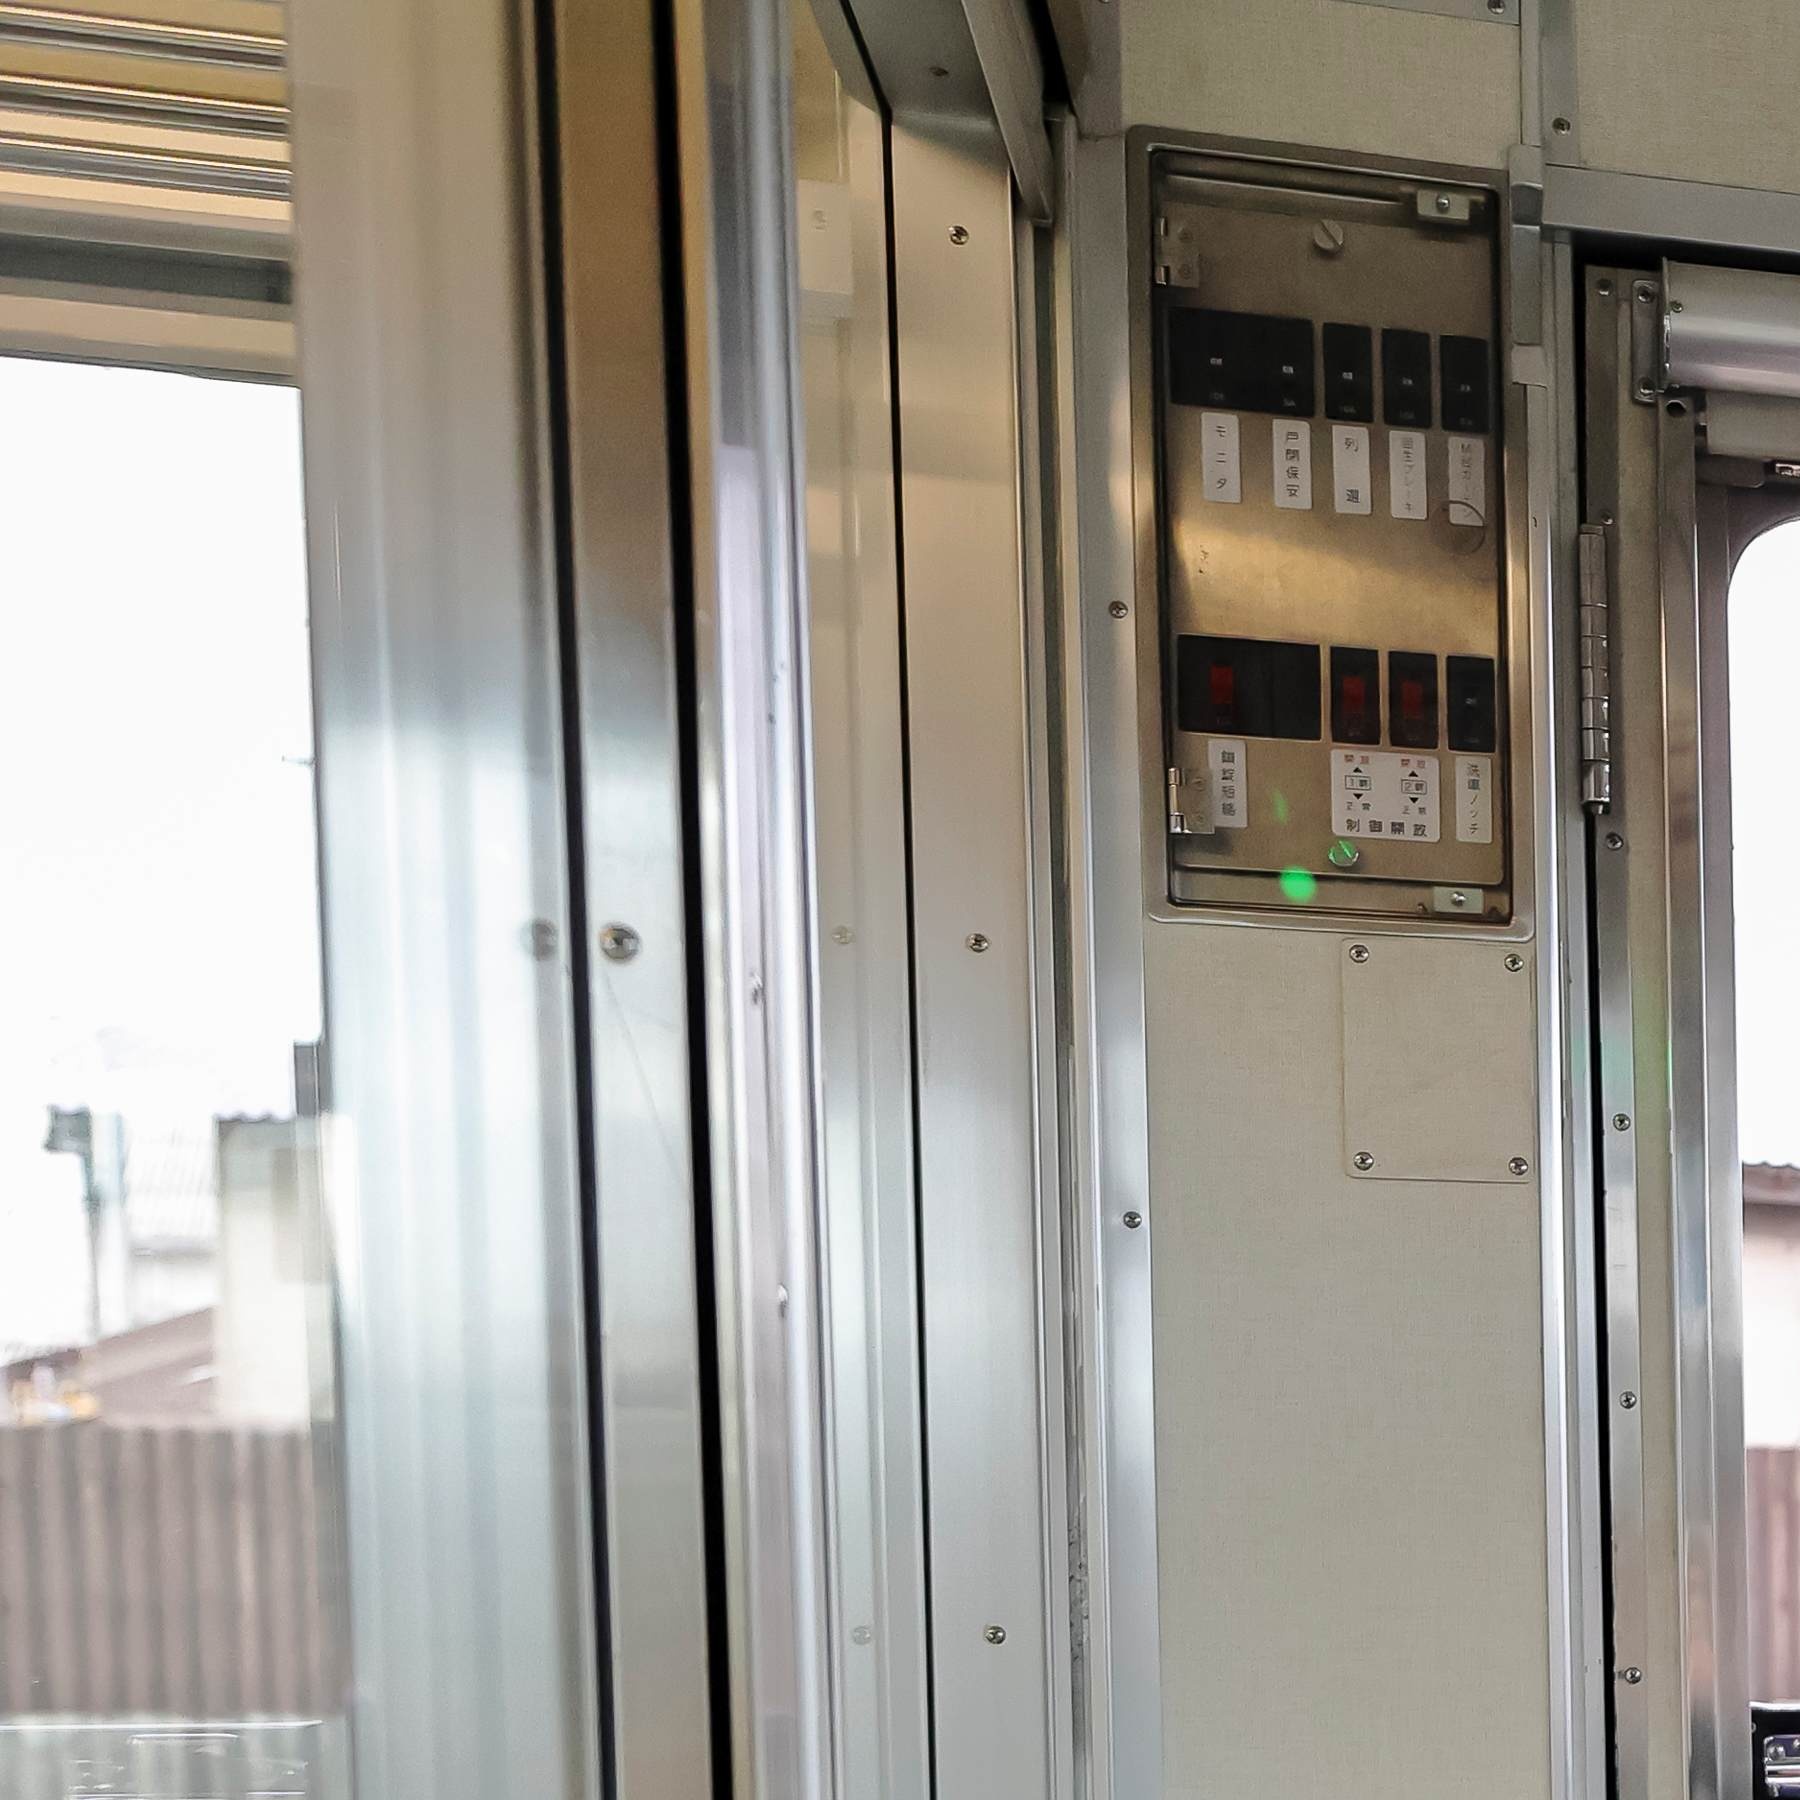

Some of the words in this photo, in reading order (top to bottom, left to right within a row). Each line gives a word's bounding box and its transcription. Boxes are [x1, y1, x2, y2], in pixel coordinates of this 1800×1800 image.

[1215, 425, 1228, 490] モニタ
[1345, 817, 1429, 838] 制御開放
[1466, 762, 1481, 836] 洗車ノッチ
